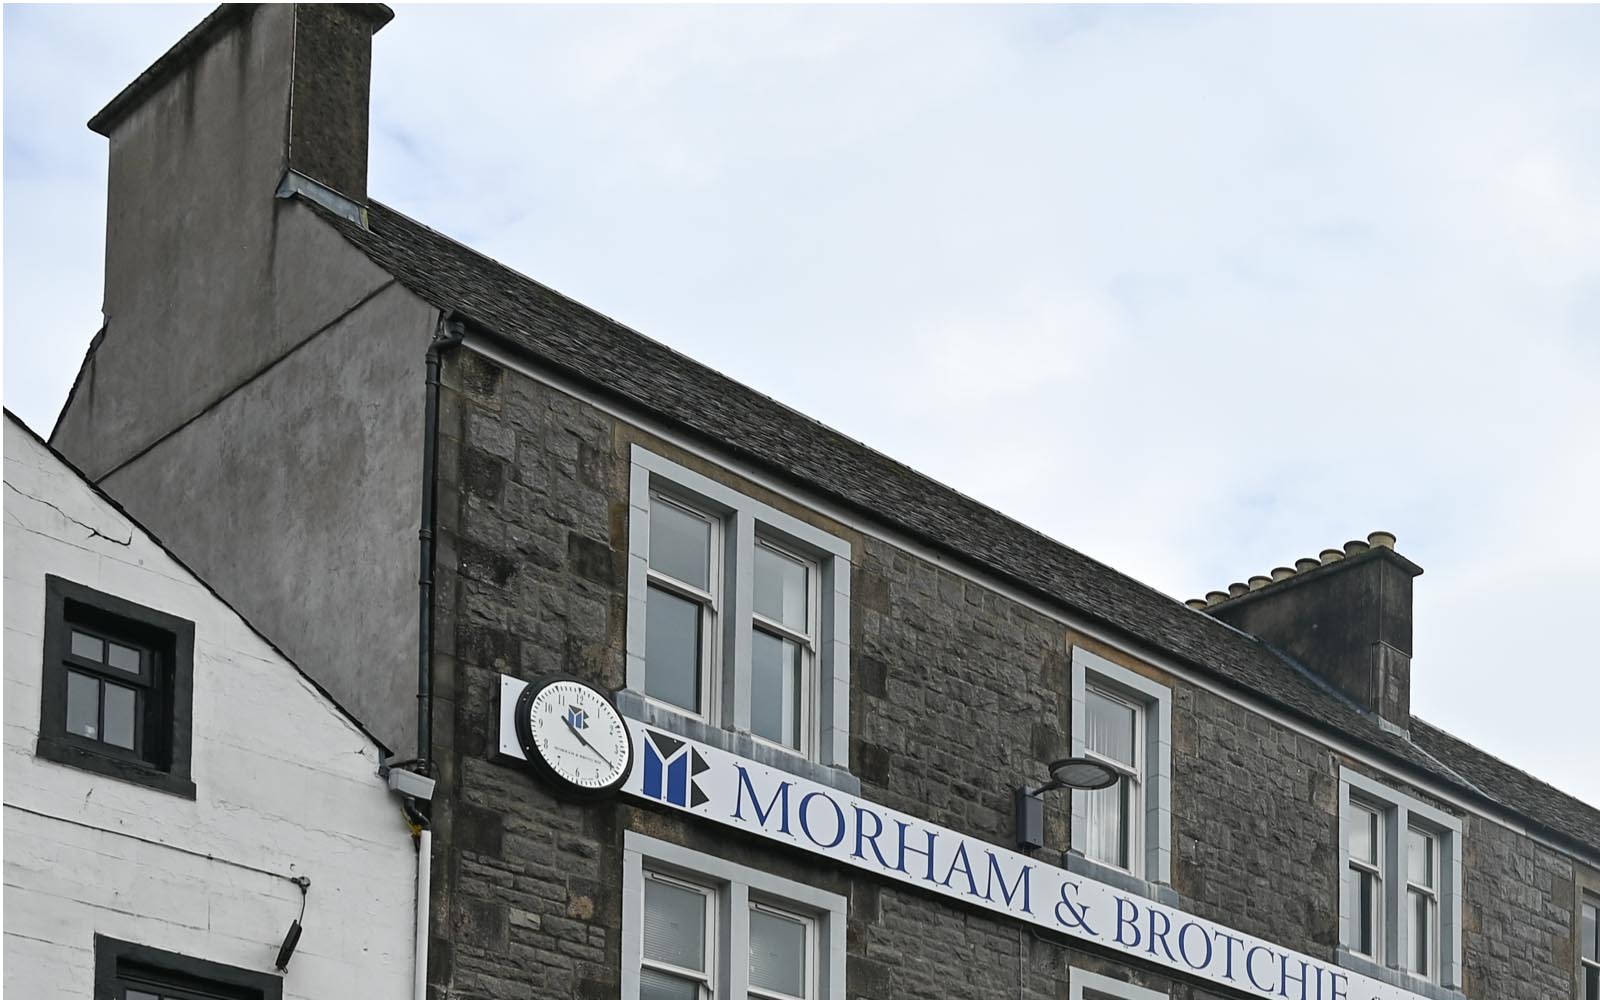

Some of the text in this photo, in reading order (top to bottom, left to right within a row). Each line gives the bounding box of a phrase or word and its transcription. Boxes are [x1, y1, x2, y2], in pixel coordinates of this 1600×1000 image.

[545, 702, 553, 713] 10
[730, 763, 1034, 914] MORHAM
[1054, 881, 1100, 936] &
